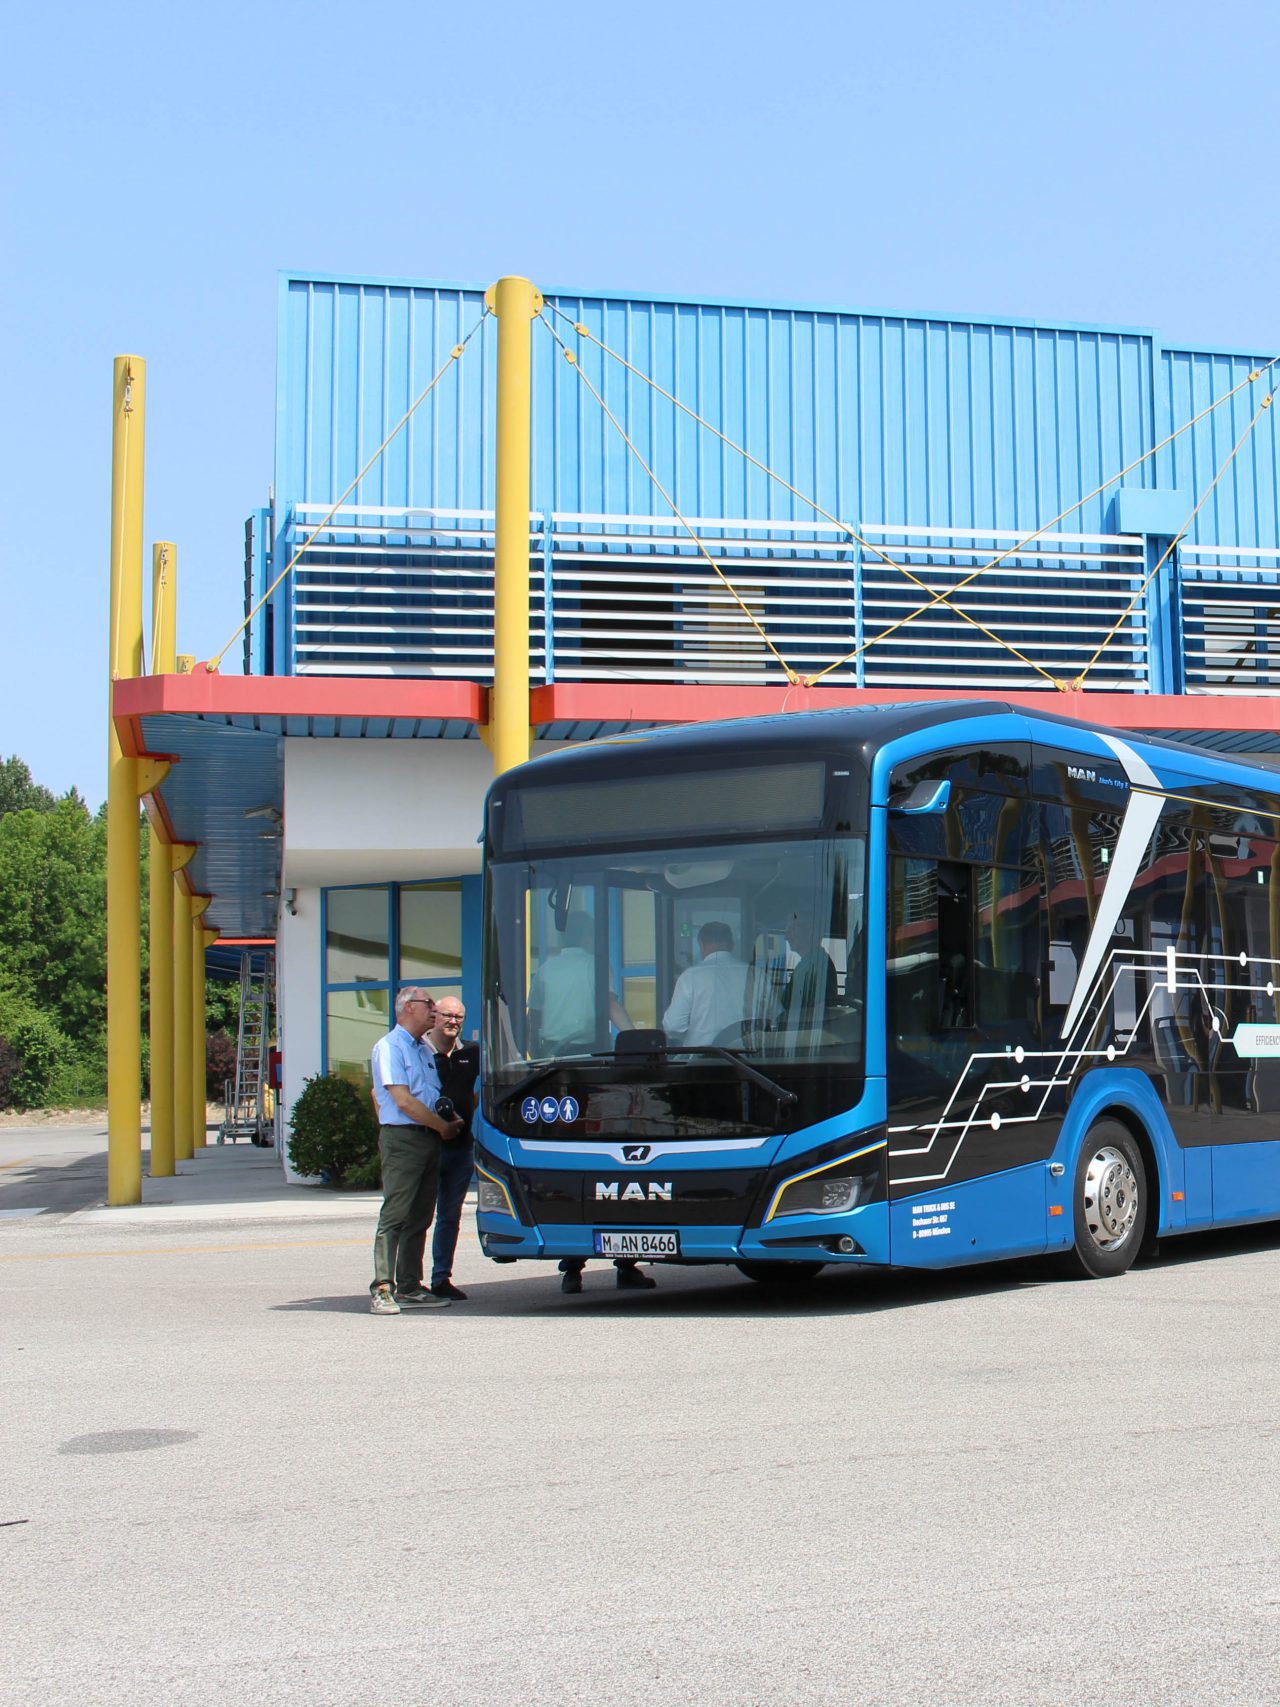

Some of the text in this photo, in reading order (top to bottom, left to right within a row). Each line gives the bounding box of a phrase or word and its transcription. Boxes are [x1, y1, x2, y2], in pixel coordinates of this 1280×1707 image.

[1067, 766, 1096, 782] MAN
[595, 1182, 672, 1200] MAN
[603, 1235, 675, 1252] M AN 8466
